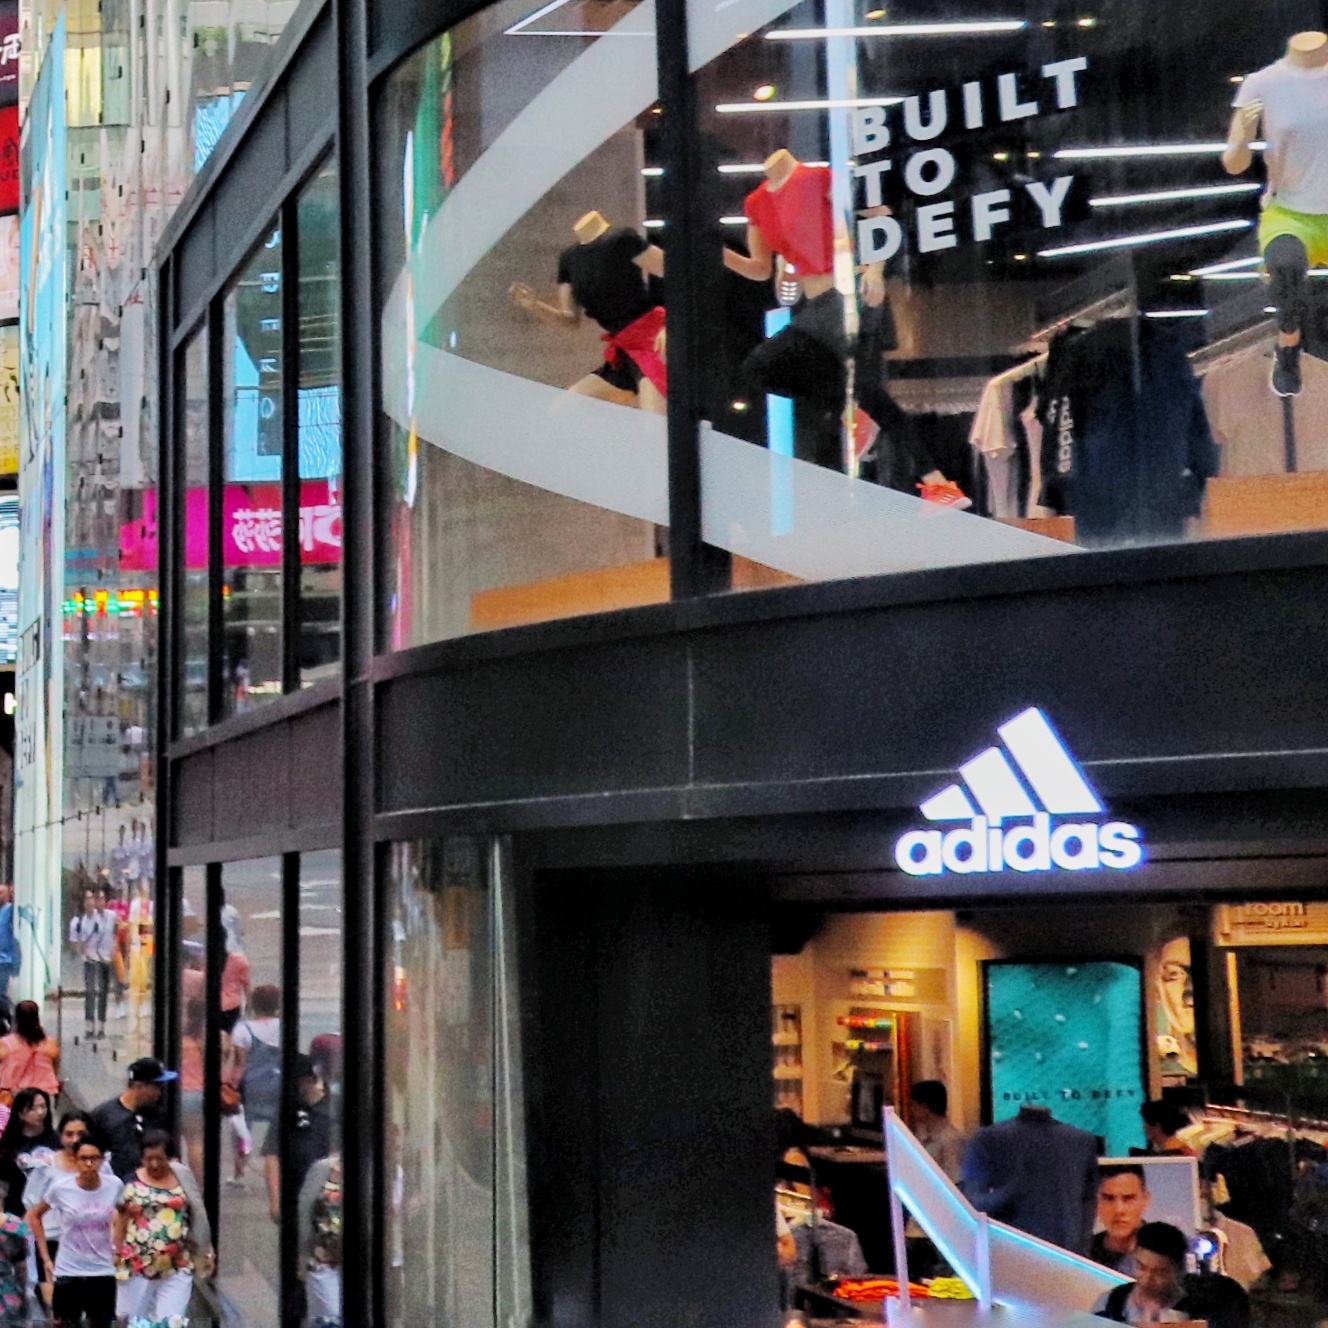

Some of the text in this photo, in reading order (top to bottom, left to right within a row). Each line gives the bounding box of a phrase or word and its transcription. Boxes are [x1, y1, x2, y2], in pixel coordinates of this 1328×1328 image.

[854, 56, 1088, 156] BUILT
[853, 148, 956, 208] TO
[857, 176, 1074, 265] DEFY
[894, 811, 1144, 877] adidas
[1003, 1088, 1135, 1101] BUILT TO DEFY
